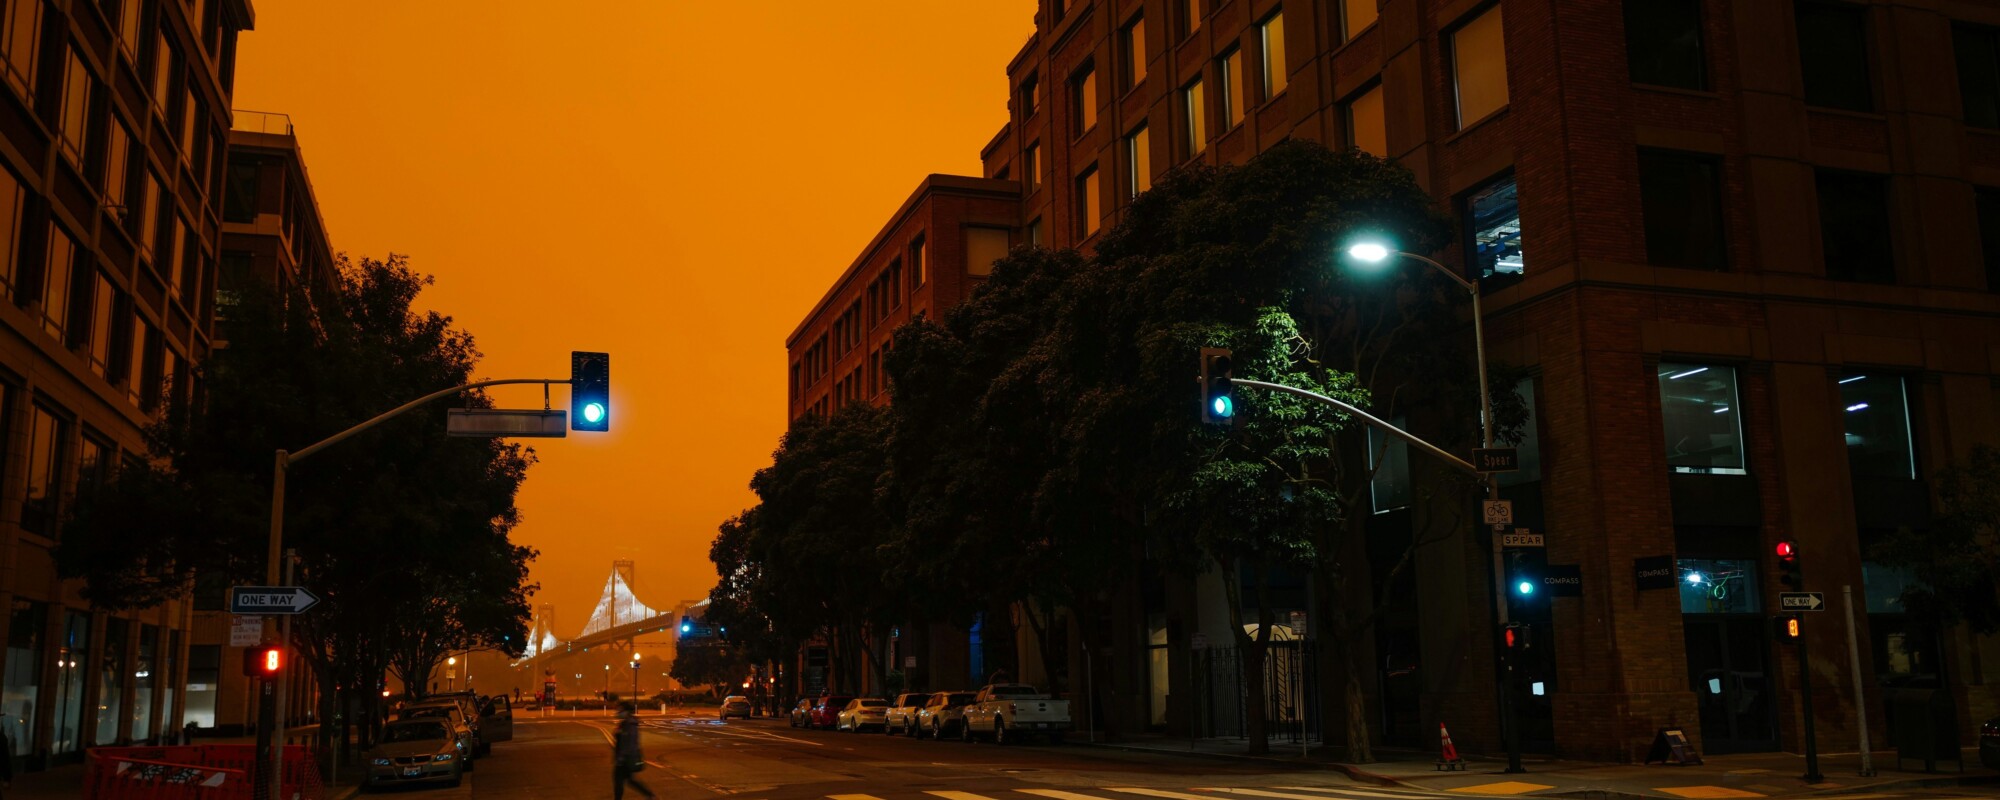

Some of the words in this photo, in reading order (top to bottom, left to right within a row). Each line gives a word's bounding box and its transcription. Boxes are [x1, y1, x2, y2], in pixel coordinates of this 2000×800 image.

[1484, 454, 1510, 470] Spear
[1505, 536, 1541, 544] SPEAR
[1639, 568, 1670, 578] COMPASS
[242, 595, 265, 605] ONE
[270, 595, 294, 605] WAY
[1785, 598, 1797, 606] ONE
[1798, 598, 1810, 606] WAY
